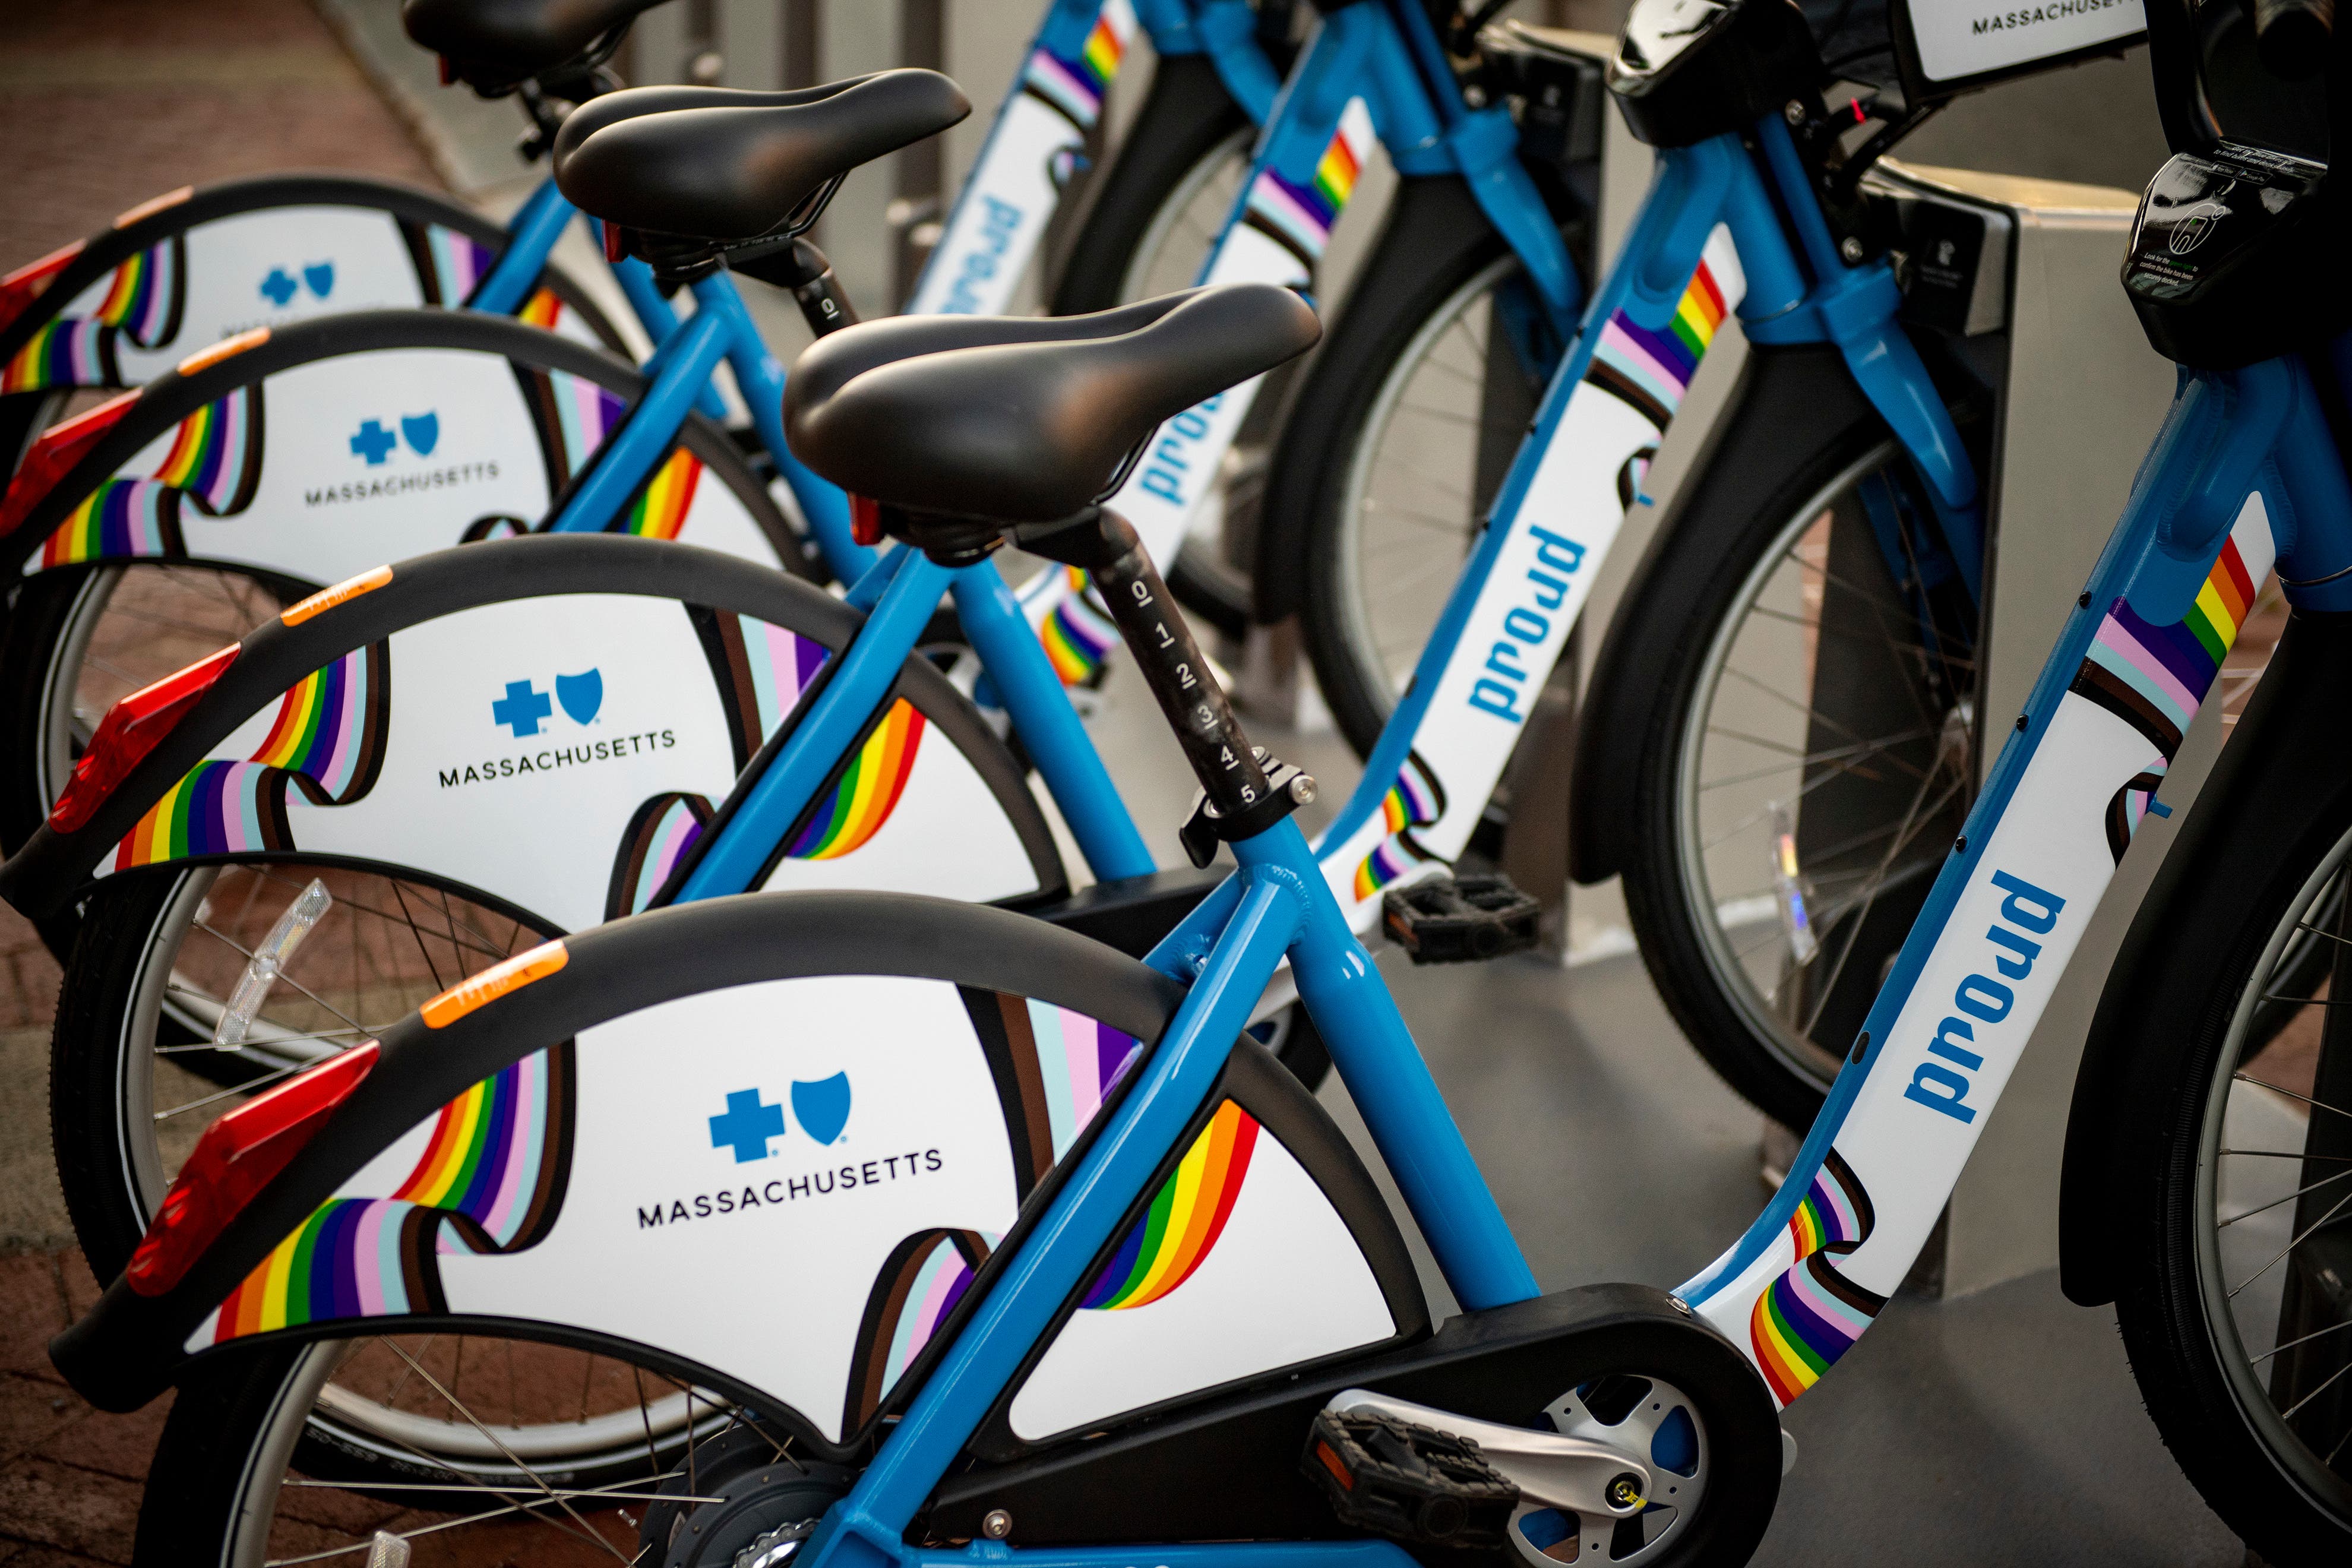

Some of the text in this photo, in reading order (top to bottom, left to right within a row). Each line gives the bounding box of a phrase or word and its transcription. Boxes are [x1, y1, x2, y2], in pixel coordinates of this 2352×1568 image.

[305, 459, 500, 506] MASSACHUSETTS
[1131, 580, 1147, 600] 0
[1155, 621, 1169, 640] 1
[1468, 523, 1586, 723] proud
[1176, 663, 1194, 684] 2
[1197, 705, 1213, 723] 3
[438, 729, 676, 789] MASSACHUSETTS
[1221, 745, 1234, 763] 4
[1240, 785, 1256, 803] 5
[1904, 870, 2066, 1125] proud
[637, 1149, 943, 1229] MASSACHUSETTS
